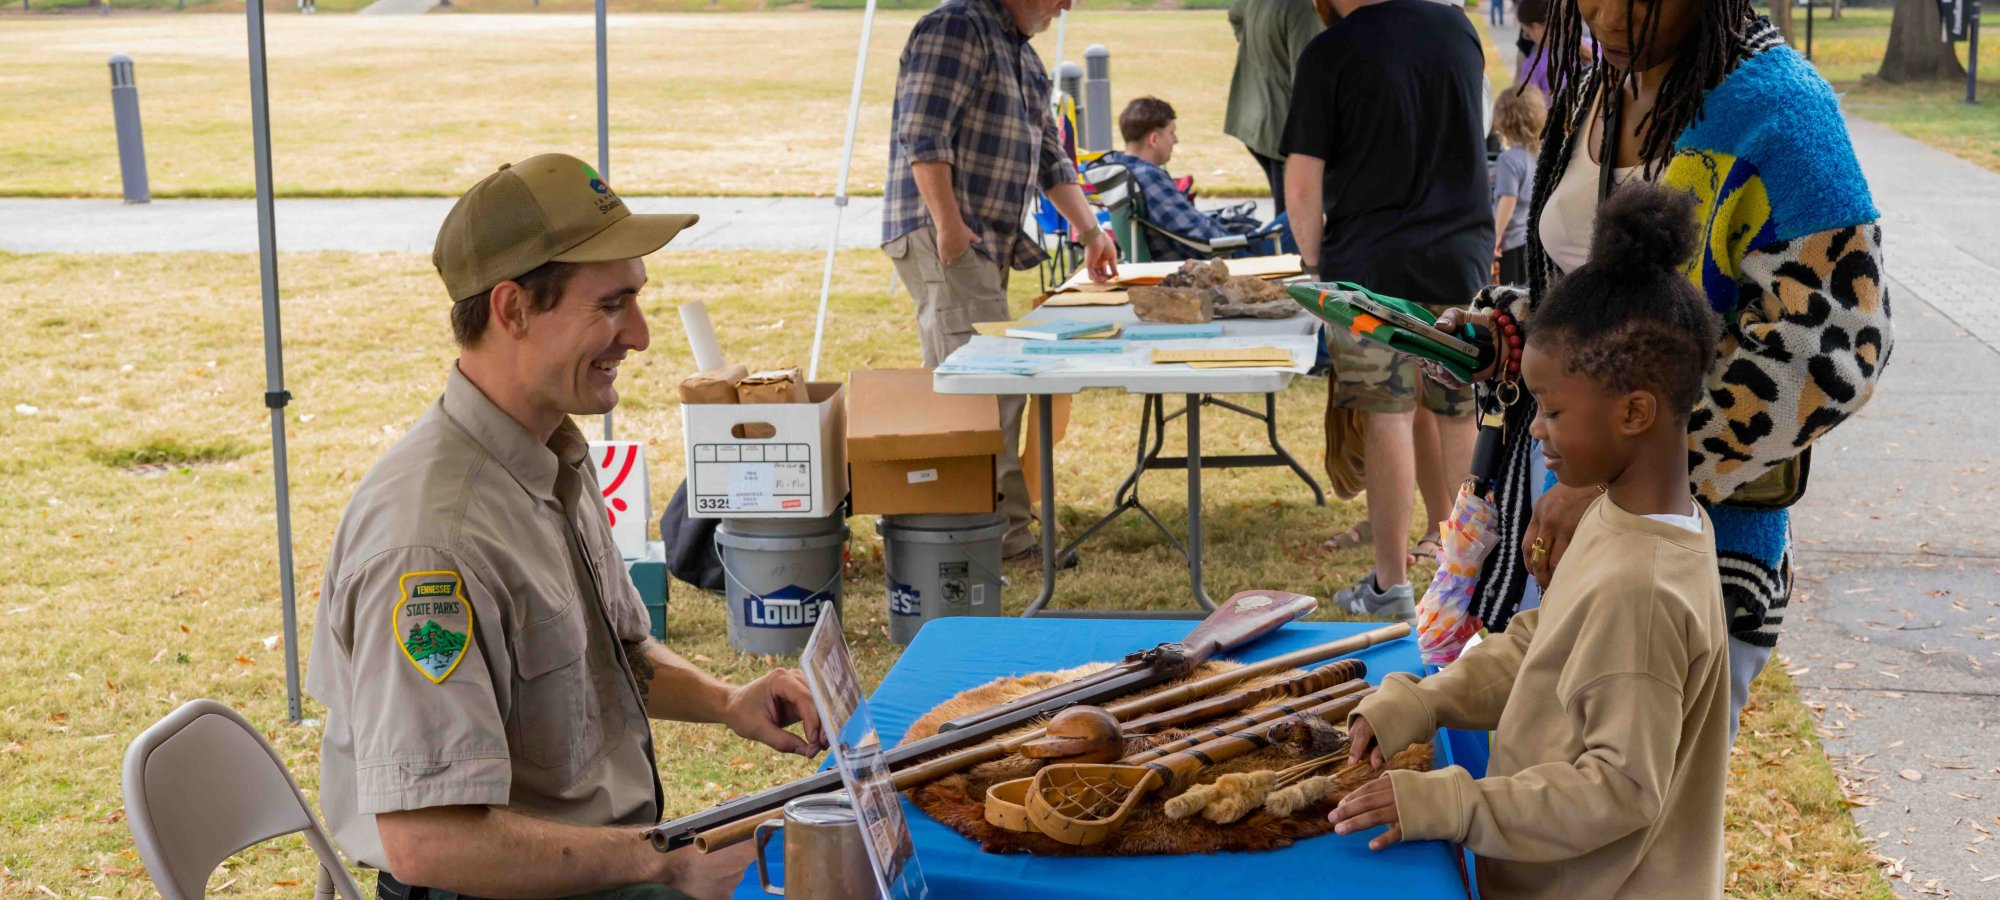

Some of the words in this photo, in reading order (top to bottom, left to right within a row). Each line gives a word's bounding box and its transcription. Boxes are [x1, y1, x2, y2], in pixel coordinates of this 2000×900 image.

[416, 584, 452, 595] TENNESSEE
[406, 603, 431, 616] STATE
[433, 601, 460, 614] PARKS
[751, 598, 826, 625] LOWE'
